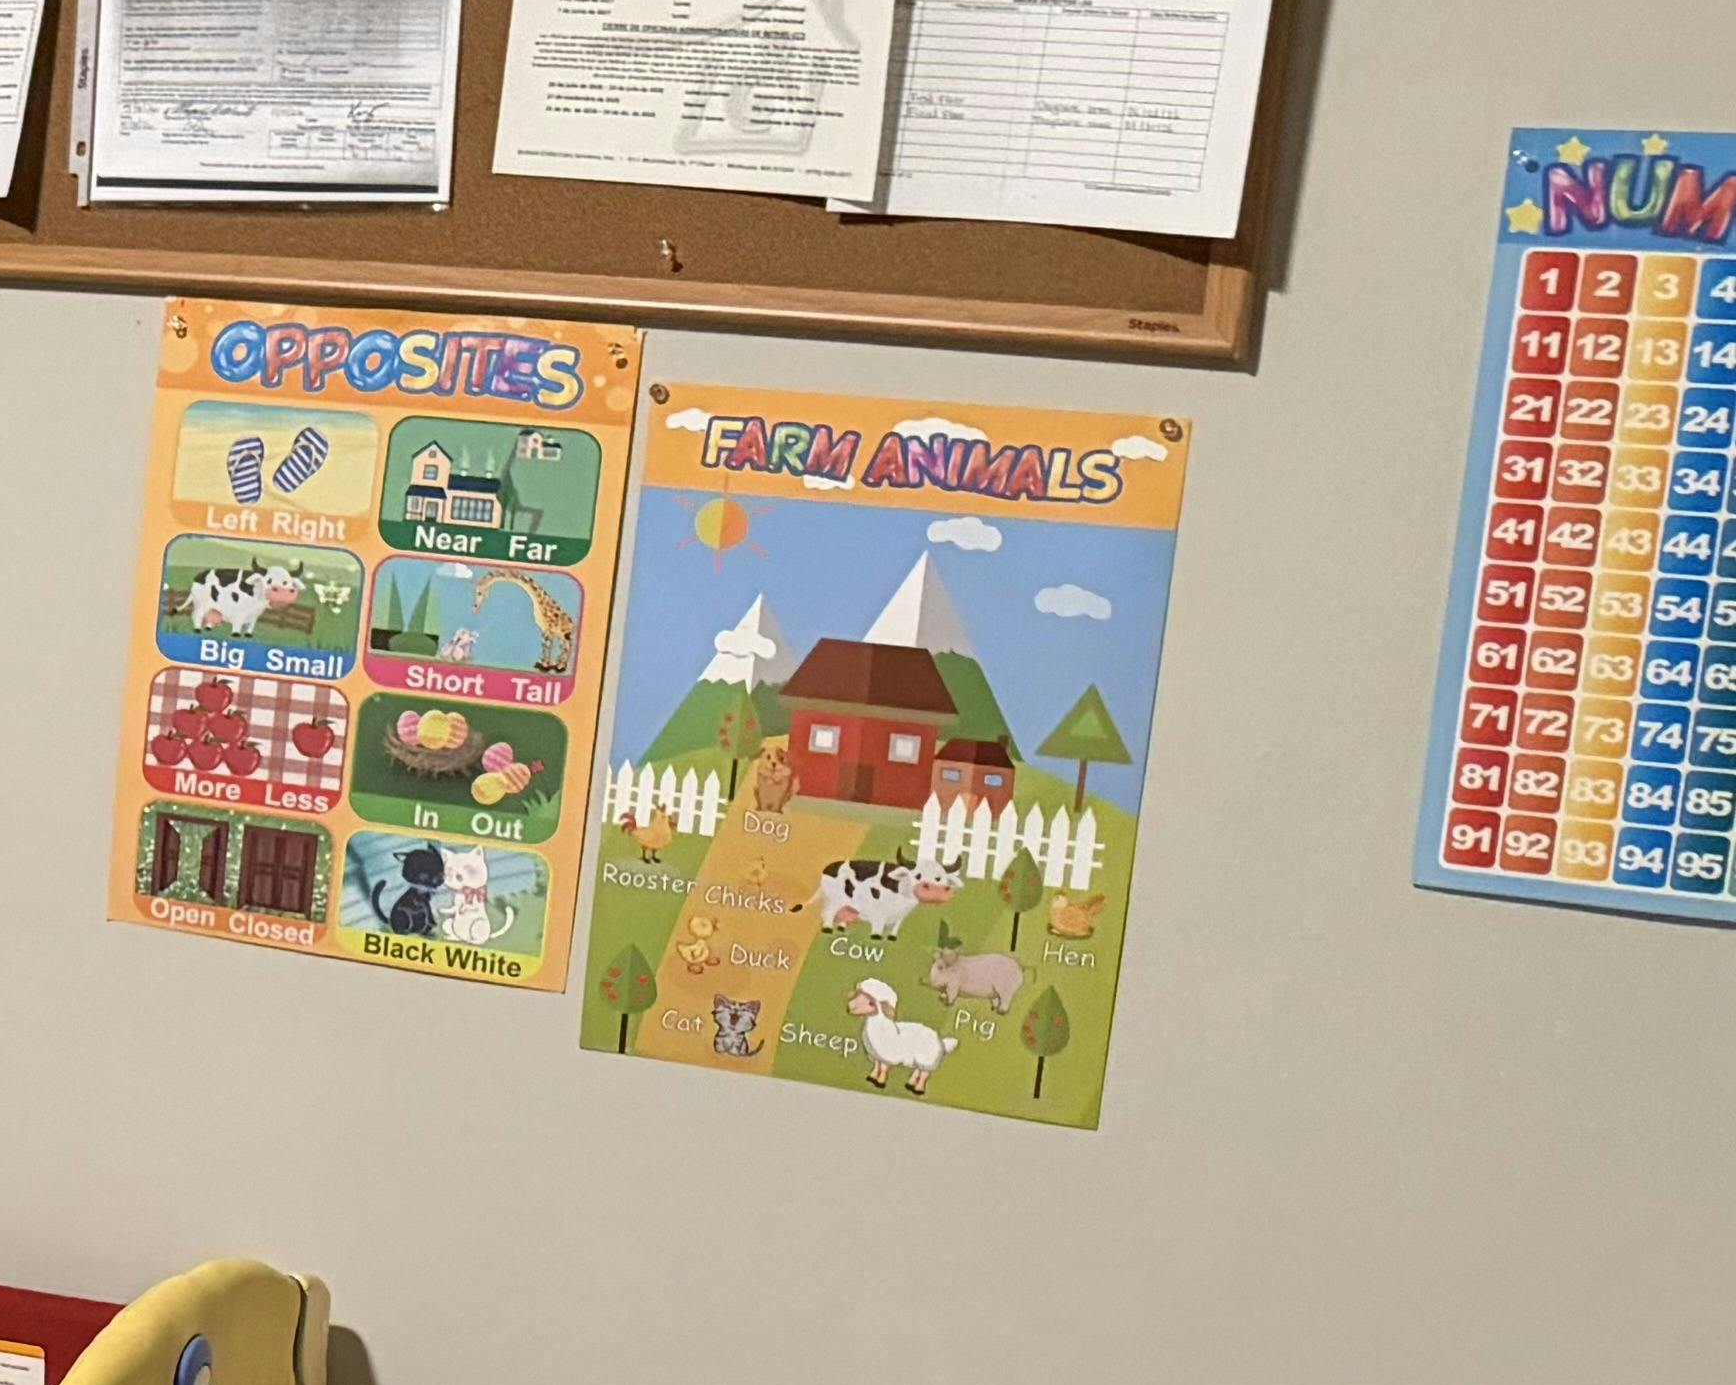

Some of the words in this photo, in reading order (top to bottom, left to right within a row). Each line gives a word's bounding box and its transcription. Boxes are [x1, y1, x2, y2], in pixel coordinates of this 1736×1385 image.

[1540, 268, 1559, 295] 1
[1594, 271, 1622, 297] 2
[1653, 273, 1679, 300] 3
[1128, 318, 1180, 333] Staples
[211, 320, 584, 410] OPPOSITES
[1510, 395, 1552, 422] 21
[702, 415, 862, 481] FARM
[867, 432, 1124, 504] ANIMALS
[206, 505, 258, 534] Left
[271, 512, 346, 541] Right
[1493, 518, 1535, 544] 41
[415, 527, 482, 555] Near
[508, 535, 557, 563] Far
[1486, 580, 1527, 607] 51
[200, 639, 245, 670] Big
[265, 650, 343, 678] Small
[406, 665, 485, 697] Short
[511, 677, 561, 705] Tall
[174, 773, 241, 801] More
[264, 784, 329, 812] Less
[414, 806, 439, 829] In
[472, 813, 523, 840] Out
[743, 813, 790, 843] Dog
[1618, 844, 1664, 873] 94
[602, 862, 697, 896] Rooster
[704, 884, 785, 914] Chicks
[150, 898, 215, 930] Open
[229, 913, 315, 947] Closed
[364, 934, 435, 964] Black
[445, 947, 522, 977] White
[730, 943, 790, 971] Duck
[830, 937, 885, 963] Cow
[1044, 943, 1096, 968] Hen
[661, 1010, 704, 1033] Cat
[954, 1009, 997, 1041] Pig
[780, 1022, 859, 1056] Sheep
